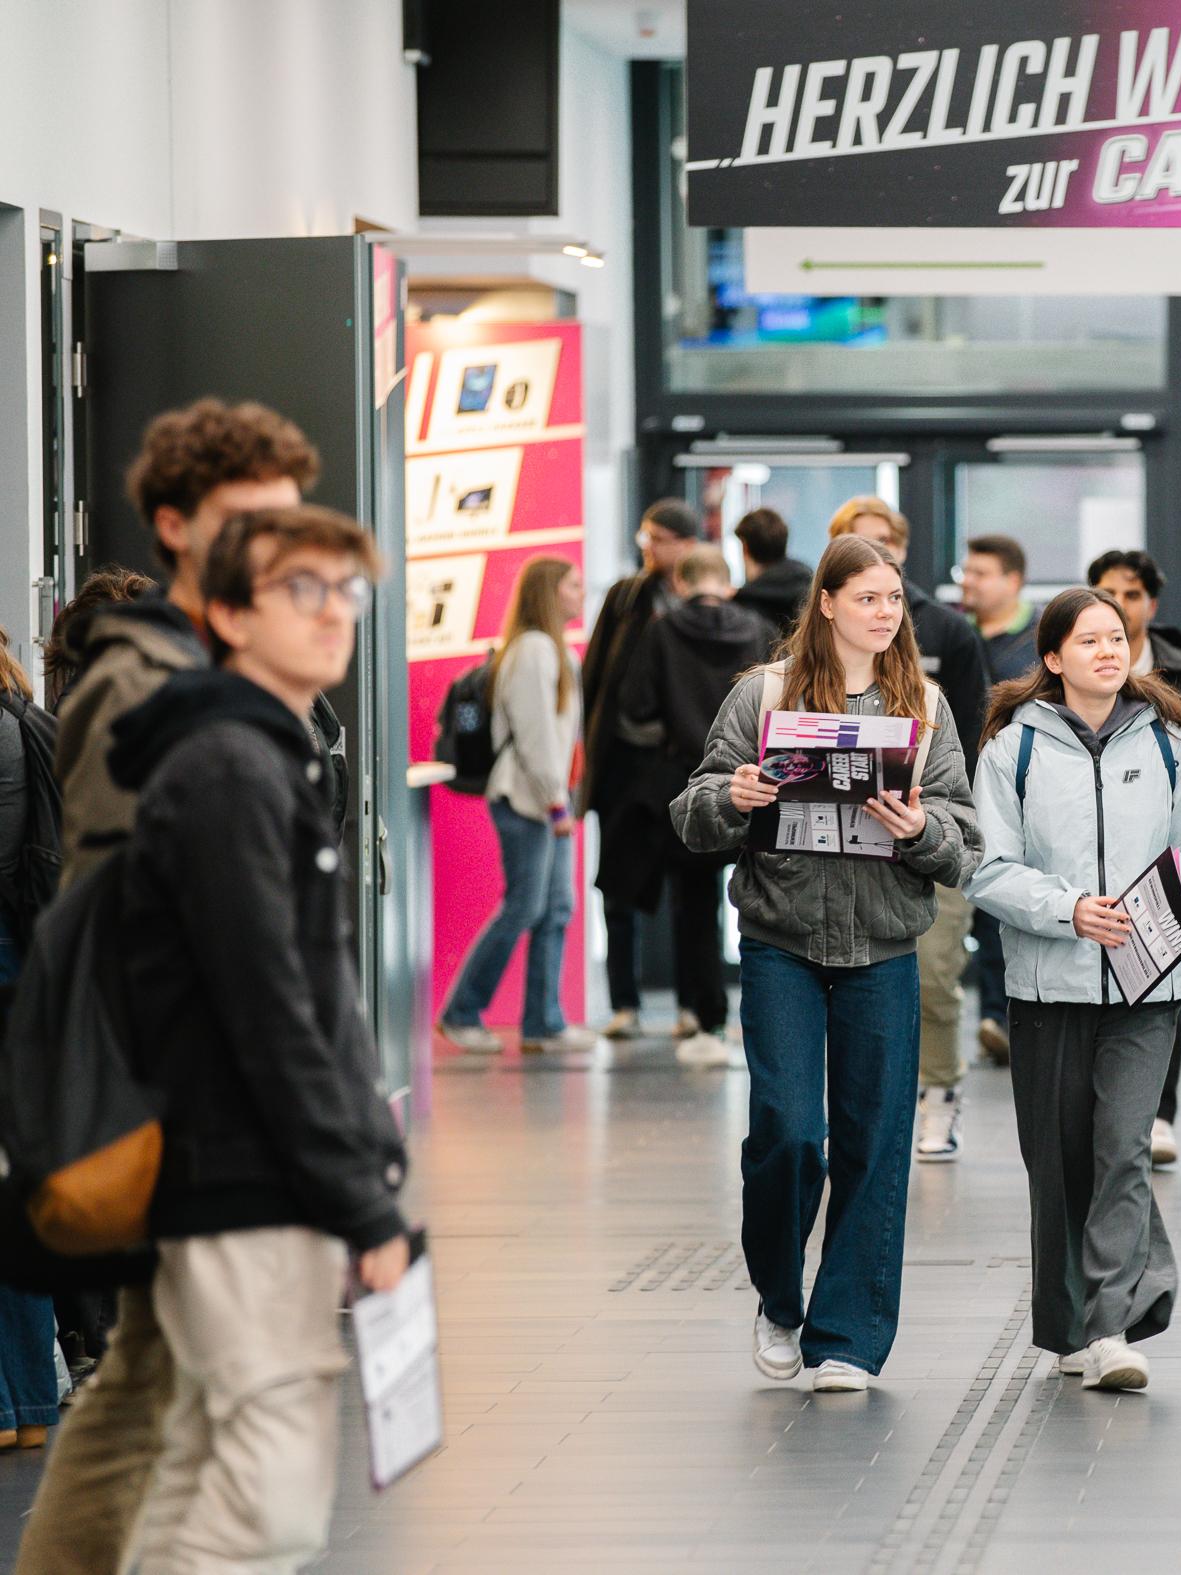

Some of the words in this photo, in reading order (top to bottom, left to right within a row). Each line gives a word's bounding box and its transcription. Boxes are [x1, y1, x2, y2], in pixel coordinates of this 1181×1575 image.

[739, 34, 1099, 160] HERZLICH
[998, 159, 1079, 214] zur
[832, 752, 851, 791] CAREER
[850, 751, 871, 781] START
